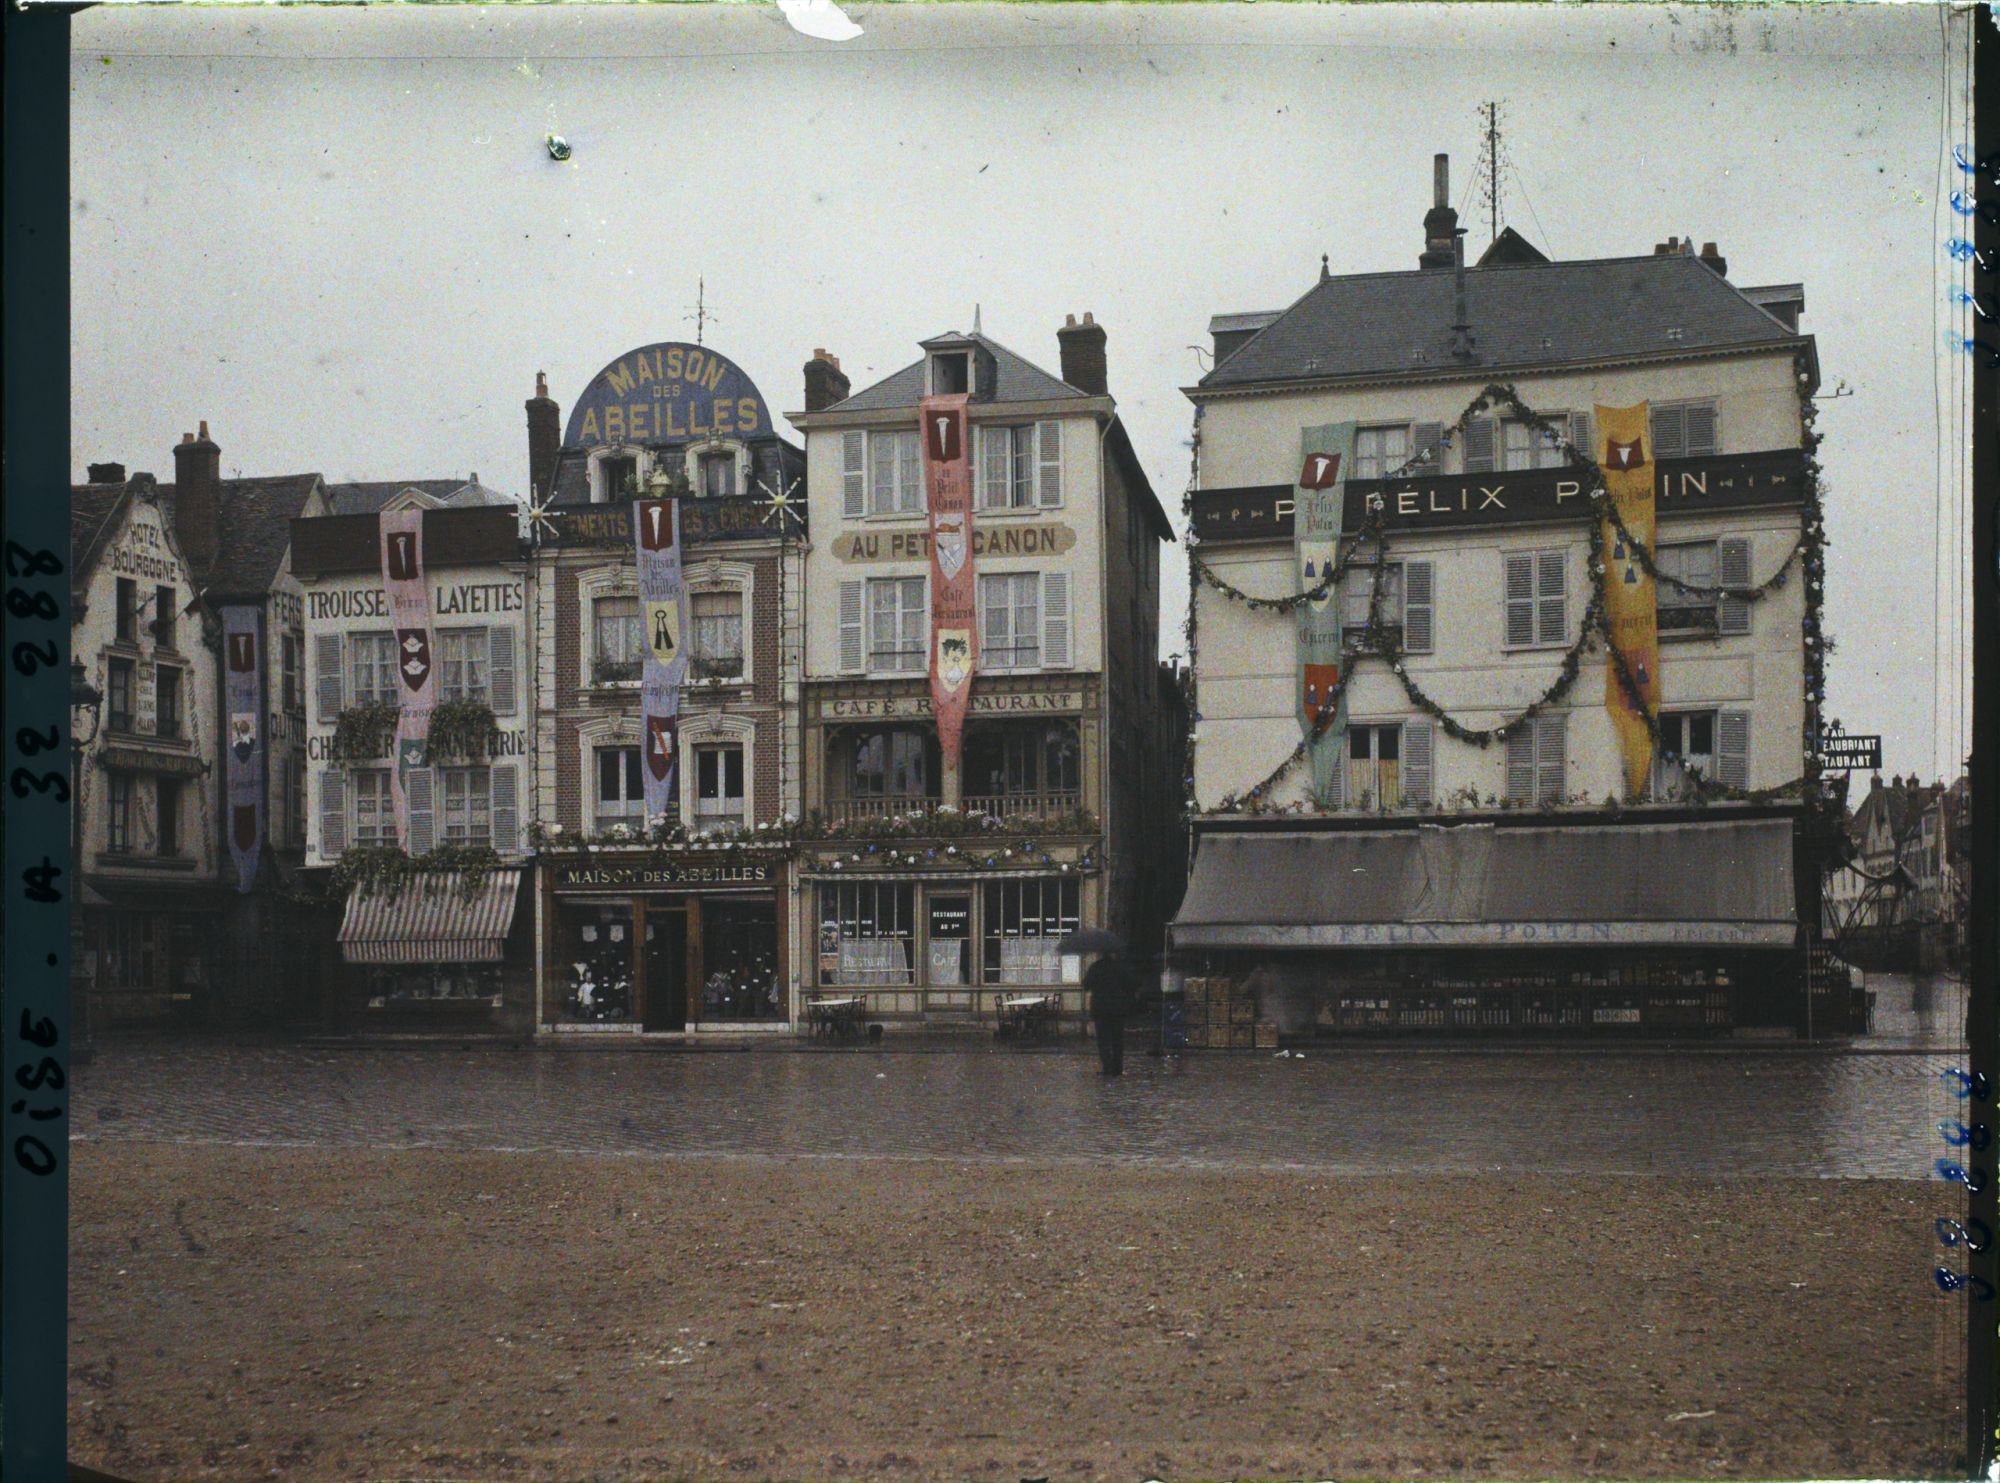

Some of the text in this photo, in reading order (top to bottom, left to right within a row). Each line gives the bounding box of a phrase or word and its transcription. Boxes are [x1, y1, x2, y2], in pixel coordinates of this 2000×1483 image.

[606, 347, 727, 398] MAISON
[653, 385, 680, 398] DES
[579, 398, 757, 441] ABEILLES
[1556, 471, 1707, 504] PIN
[851, 528, 1056, 559] AU PET CANON
[111, 546, 177, 583] BOURGOGNE
[308, 589, 390, 619] TROUSSE
[436, 582, 523, 615] LAYETTES
[832, 694, 1073, 716] CAFÉ RTAURANT
[1823, 739, 1877, 752] EAUBRIANT
[1824, 755, 1871, 768] TAURANT
[644, 870, 670, 882] DES
[676, 867, 766, 882] ABEILLES
[1499, 923, 1611, 941] POTIN
